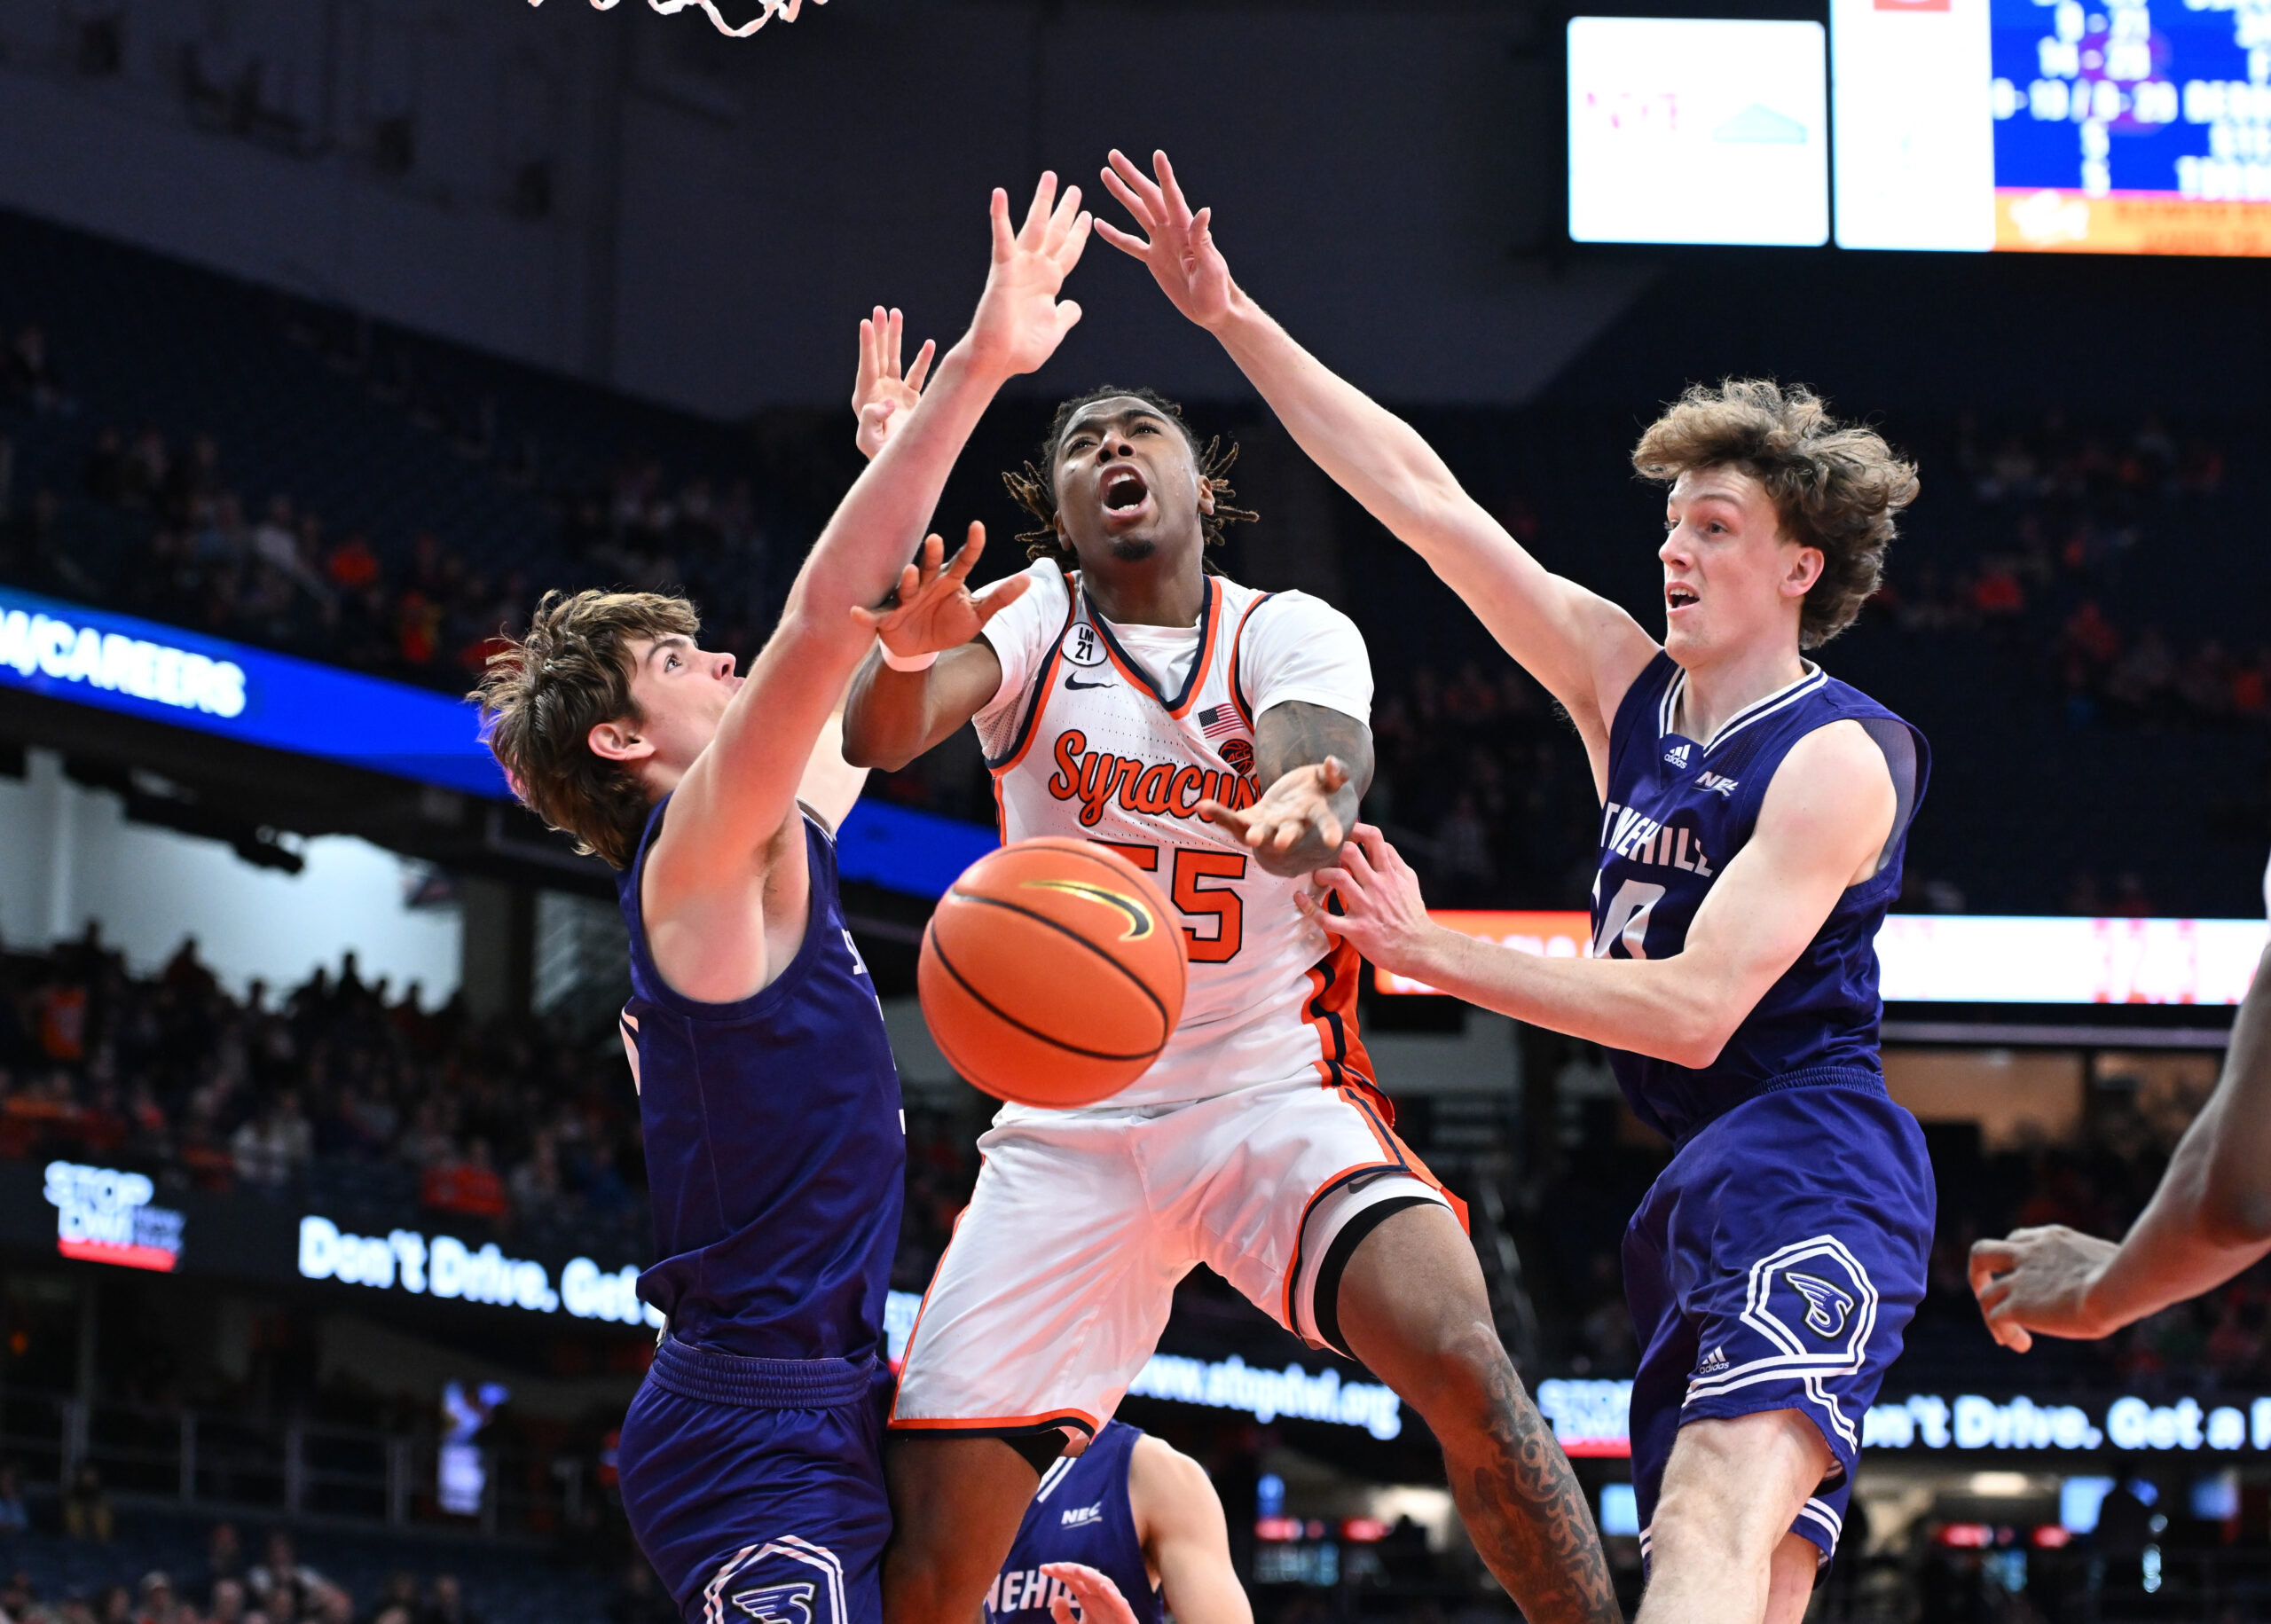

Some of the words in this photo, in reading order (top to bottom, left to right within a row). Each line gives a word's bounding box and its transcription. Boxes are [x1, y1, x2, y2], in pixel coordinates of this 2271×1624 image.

[1079, 626, 1095, 643] LM
[1075, 640, 1093, 662] 21
[1226, 748, 1252, 764] ACC
[1664, 753, 1687, 769] adidas
[1087, 838, 1247, 963] 5
[43, 1160, 154, 1208] STOP
[299, 1215, 427, 1294] Don't
[429, 1236, 560, 1314] Drive.
[1699, 1361, 1730, 1374] adidas
[1953, 1394, 2103, 1450] Drive.
[2106, 1395, 2204, 1451] Get
[2206, 1406, 2246, 1451] a
[1061, 1502, 1102, 1525] NEC
